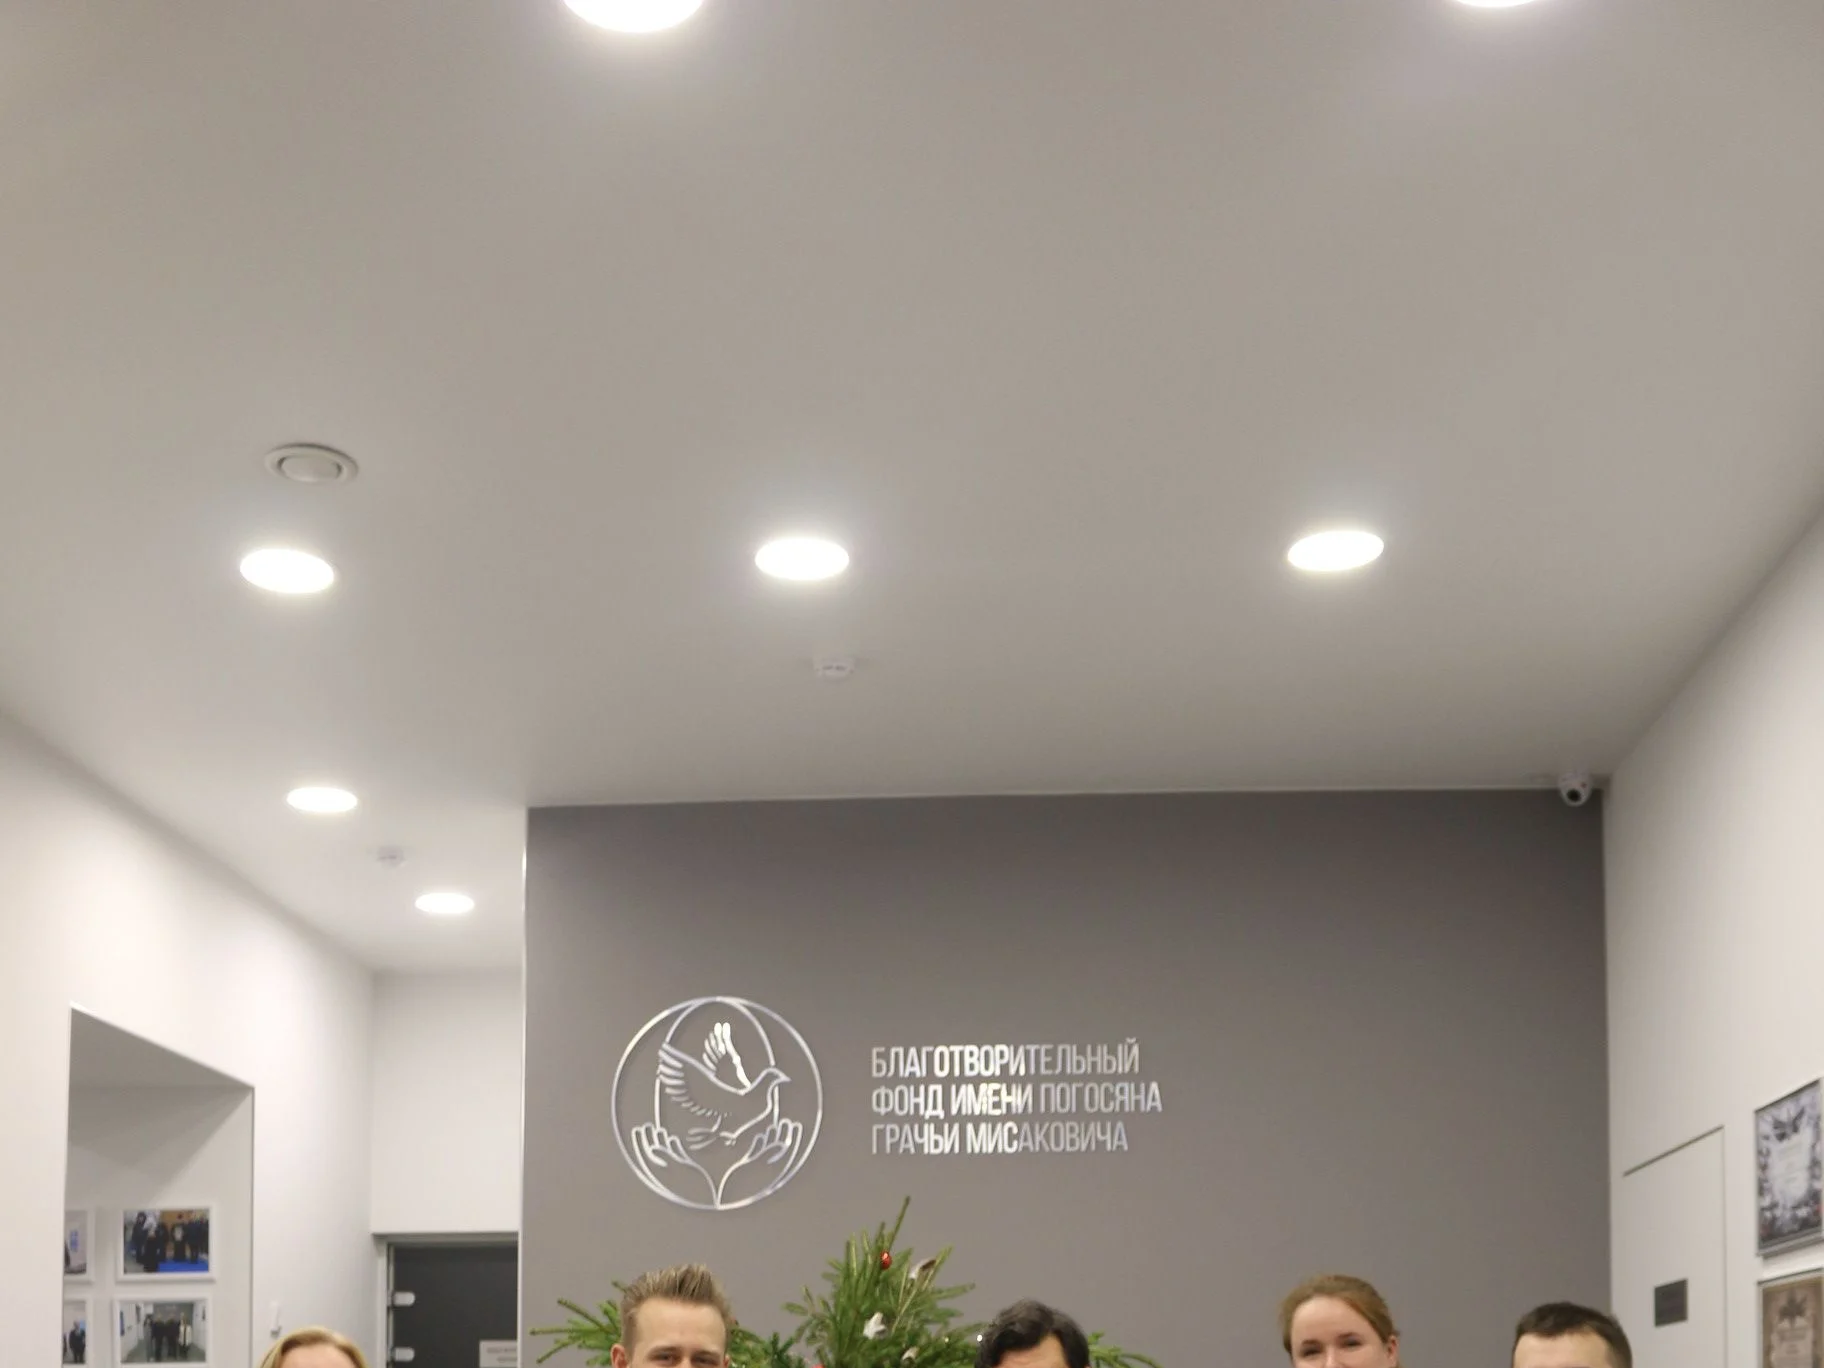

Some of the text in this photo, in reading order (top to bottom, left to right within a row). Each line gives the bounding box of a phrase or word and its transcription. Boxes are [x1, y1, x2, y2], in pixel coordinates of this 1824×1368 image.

[871, 1037, 1140, 1078] БЛАГОТВОРИТЕЛЬНЫЙ
[871, 1081, 1163, 1120] ФОНД ИМЕНИ ПОГОСЯНА
[871, 1121, 1129, 1155] ГРАЧЬИ МИСАКОВИЧА
